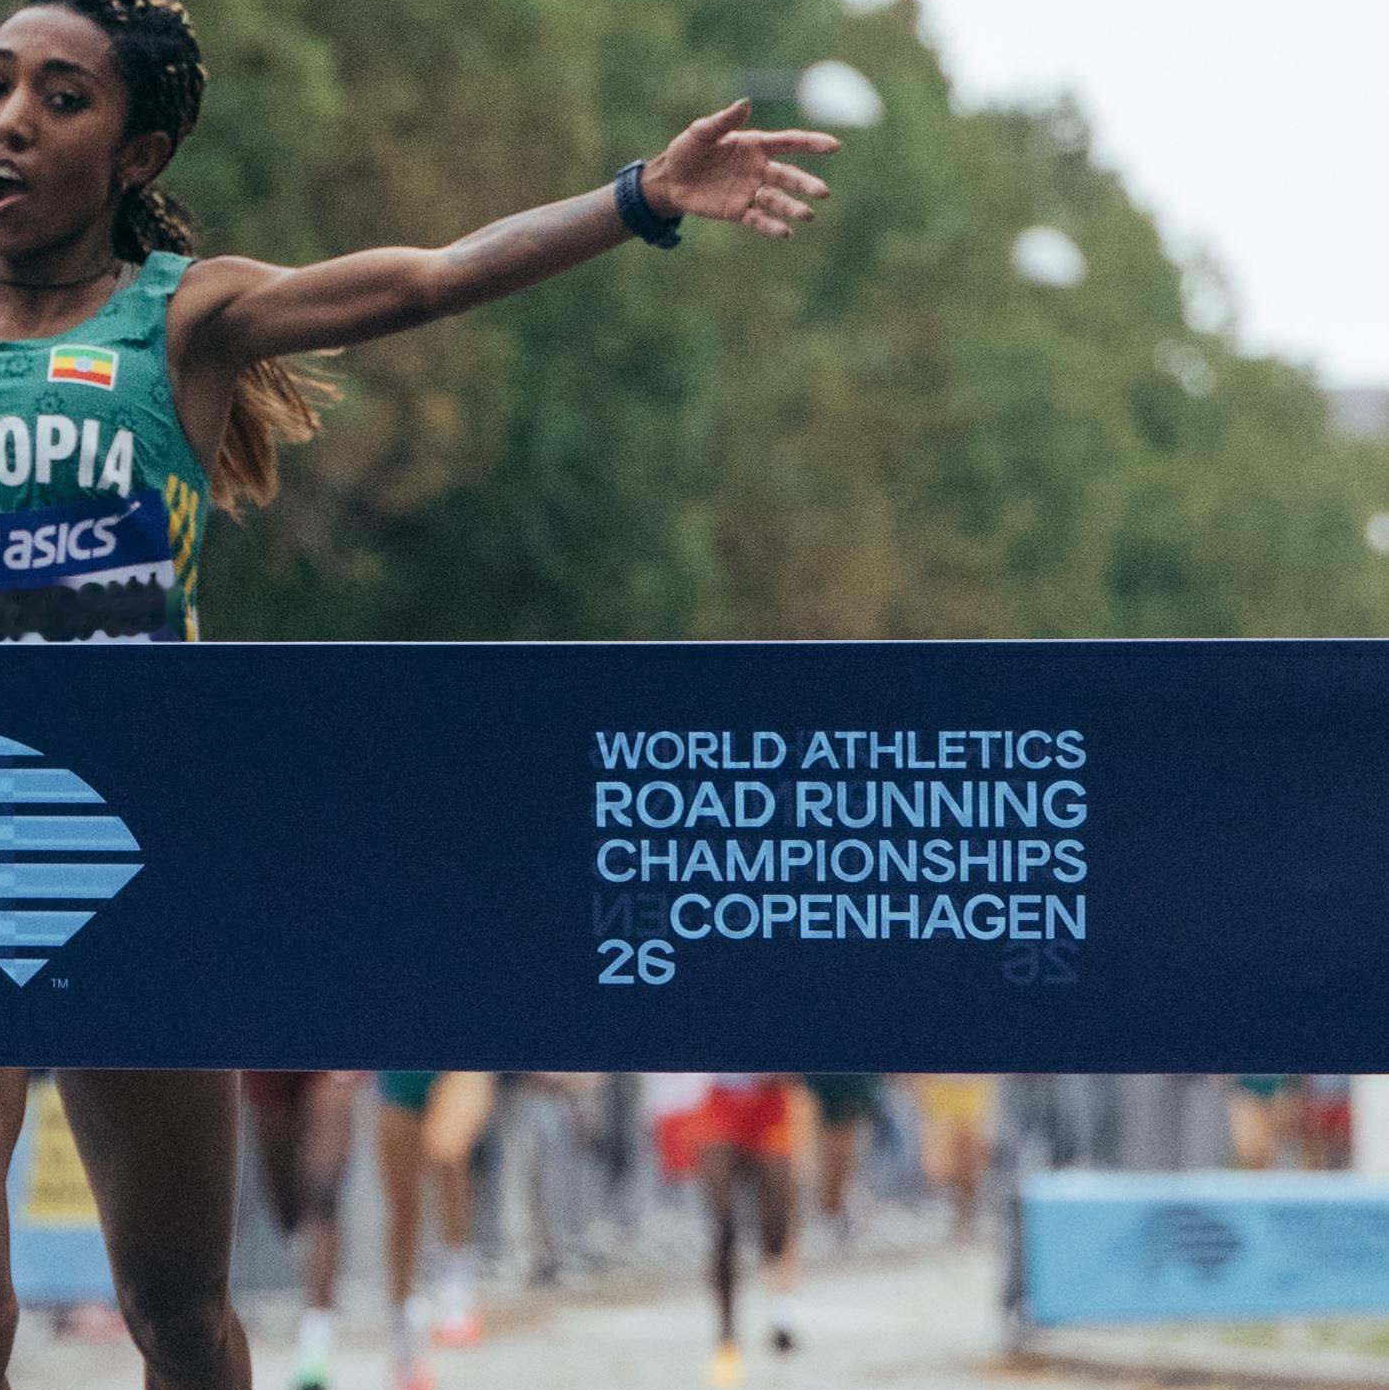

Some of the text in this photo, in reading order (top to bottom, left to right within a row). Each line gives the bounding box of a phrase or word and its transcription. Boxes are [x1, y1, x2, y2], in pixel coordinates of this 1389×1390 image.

[595, 729, 1087, 770] WORLD ATHLETICS
[595, 779, 1088, 829] ROAD RUNNING
[596, 838, 1088, 884] CHAMPIONSHIPS
[669, 892, 1087, 941] COPENHAGEN
[596, 938, 676, 986] 26
